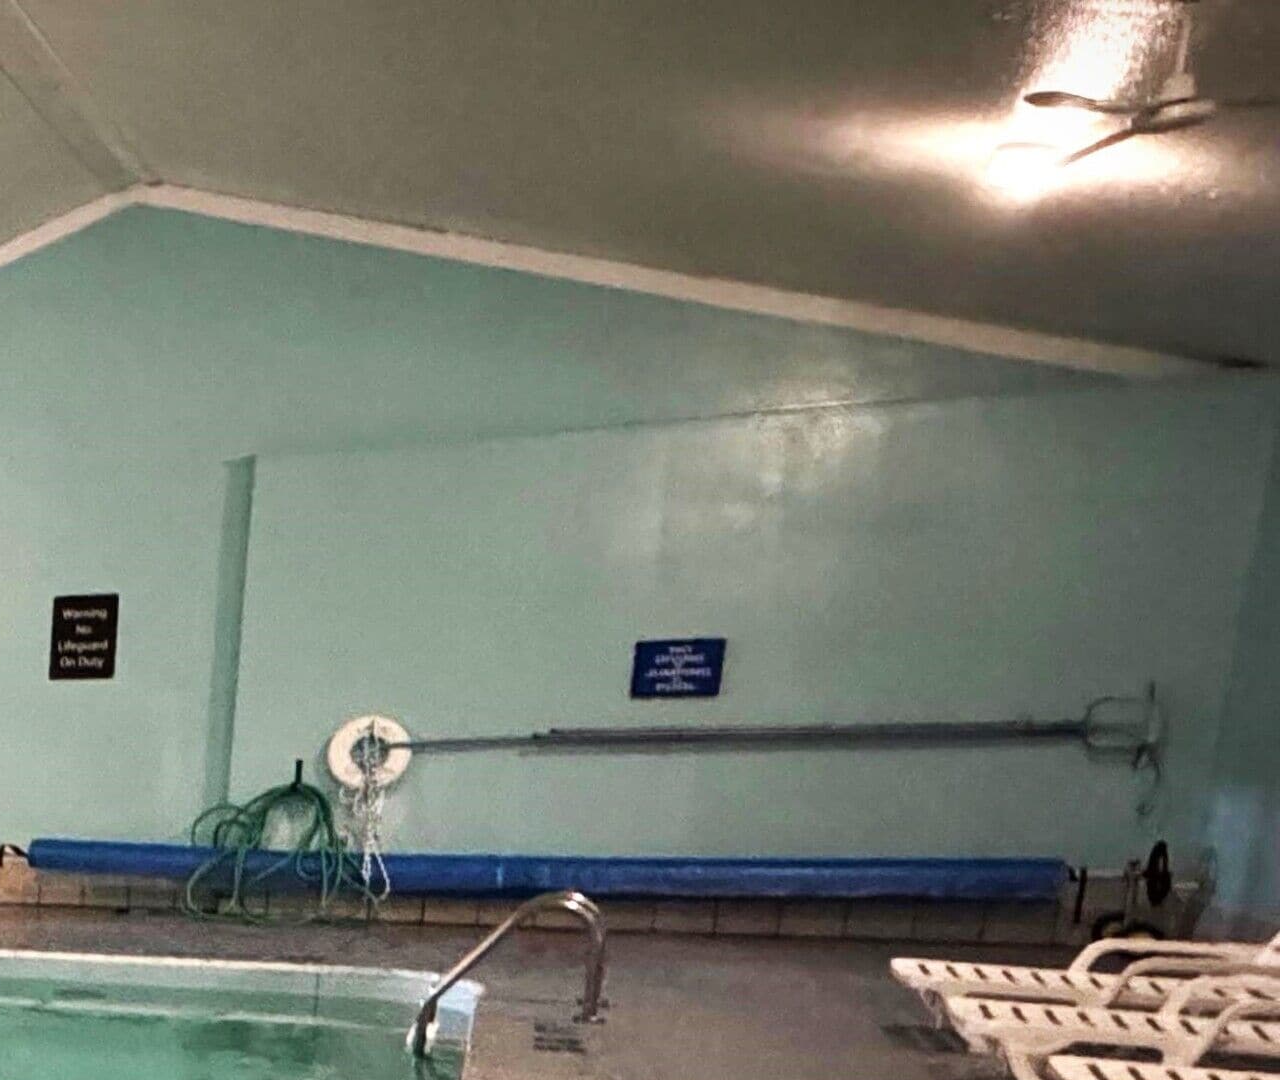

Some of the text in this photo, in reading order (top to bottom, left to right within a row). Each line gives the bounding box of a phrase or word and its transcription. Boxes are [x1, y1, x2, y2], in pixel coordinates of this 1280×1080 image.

[62, 608, 108, 621] Warning
[75, 624, 92, 635] No
[57, 639, 108, 654] Lifeguard
[60, 655, 104, 669] On Duty
